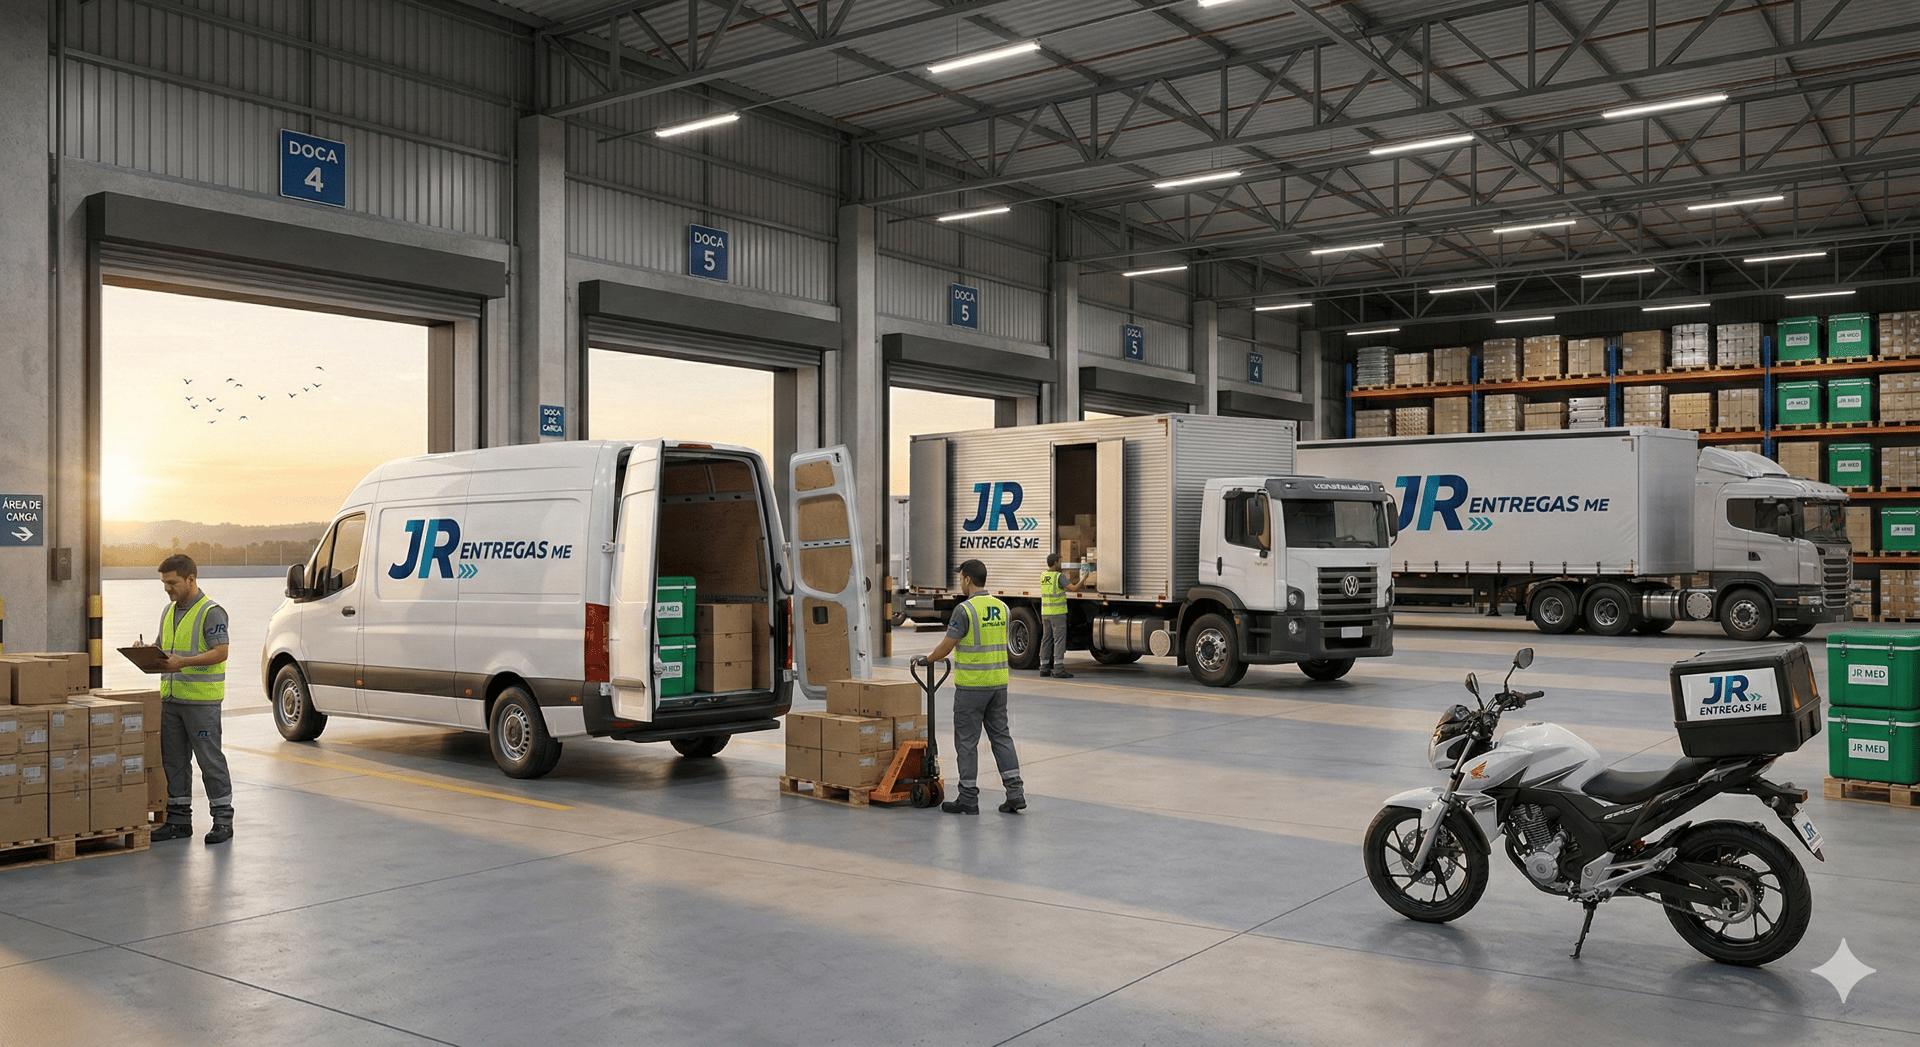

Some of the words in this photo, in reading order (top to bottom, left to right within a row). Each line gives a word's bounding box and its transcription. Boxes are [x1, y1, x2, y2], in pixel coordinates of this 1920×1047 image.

[289, 140, 338, 164] DOCA
[304, 166, 324, 193] 4
[694, 231, 725, 248] DOCA
[703, 250, 716, 271] 5
[955, 290, 975, 302] DOCA
[962, 304, 970, 321] 5
[1132, 340, 1138, 355] 5
[1254, 365, 1259, 379] 4
[2, 497, 28, 509] ÁREA
[29, 500, 41, 509] DE
[963, 481, 1024, 532] JR
[1395, 474, 1469, 532] JR
[1469, 495, 1579, 513] ENTREGAS
[1584, 498, 1610, 512] ME
[388, 518, 461, 580] JR
[460, 541, 549, 560] ENTREGAS
[551, 545, 573, 560] ME
[960, 535, 1021, 549] ENTREGAS
[1023, 537, 1040, 549] ME
[982, 606, 1001, 621] JR
[210, 623, 226, 634] JR
[1851, 668, 1863, 677] JR
[1865, 669, 1886, 678] MED
[1702, 674, 1749, 704] JR
[1700, 703, 1751, 715] ENTREGAS
[1753, 703, 1767, 712] ME
[1852, 743, 1863, 752] JR
[1865, 744, 1886, 753] MED
[1803, 821, 1817, 840] JR
